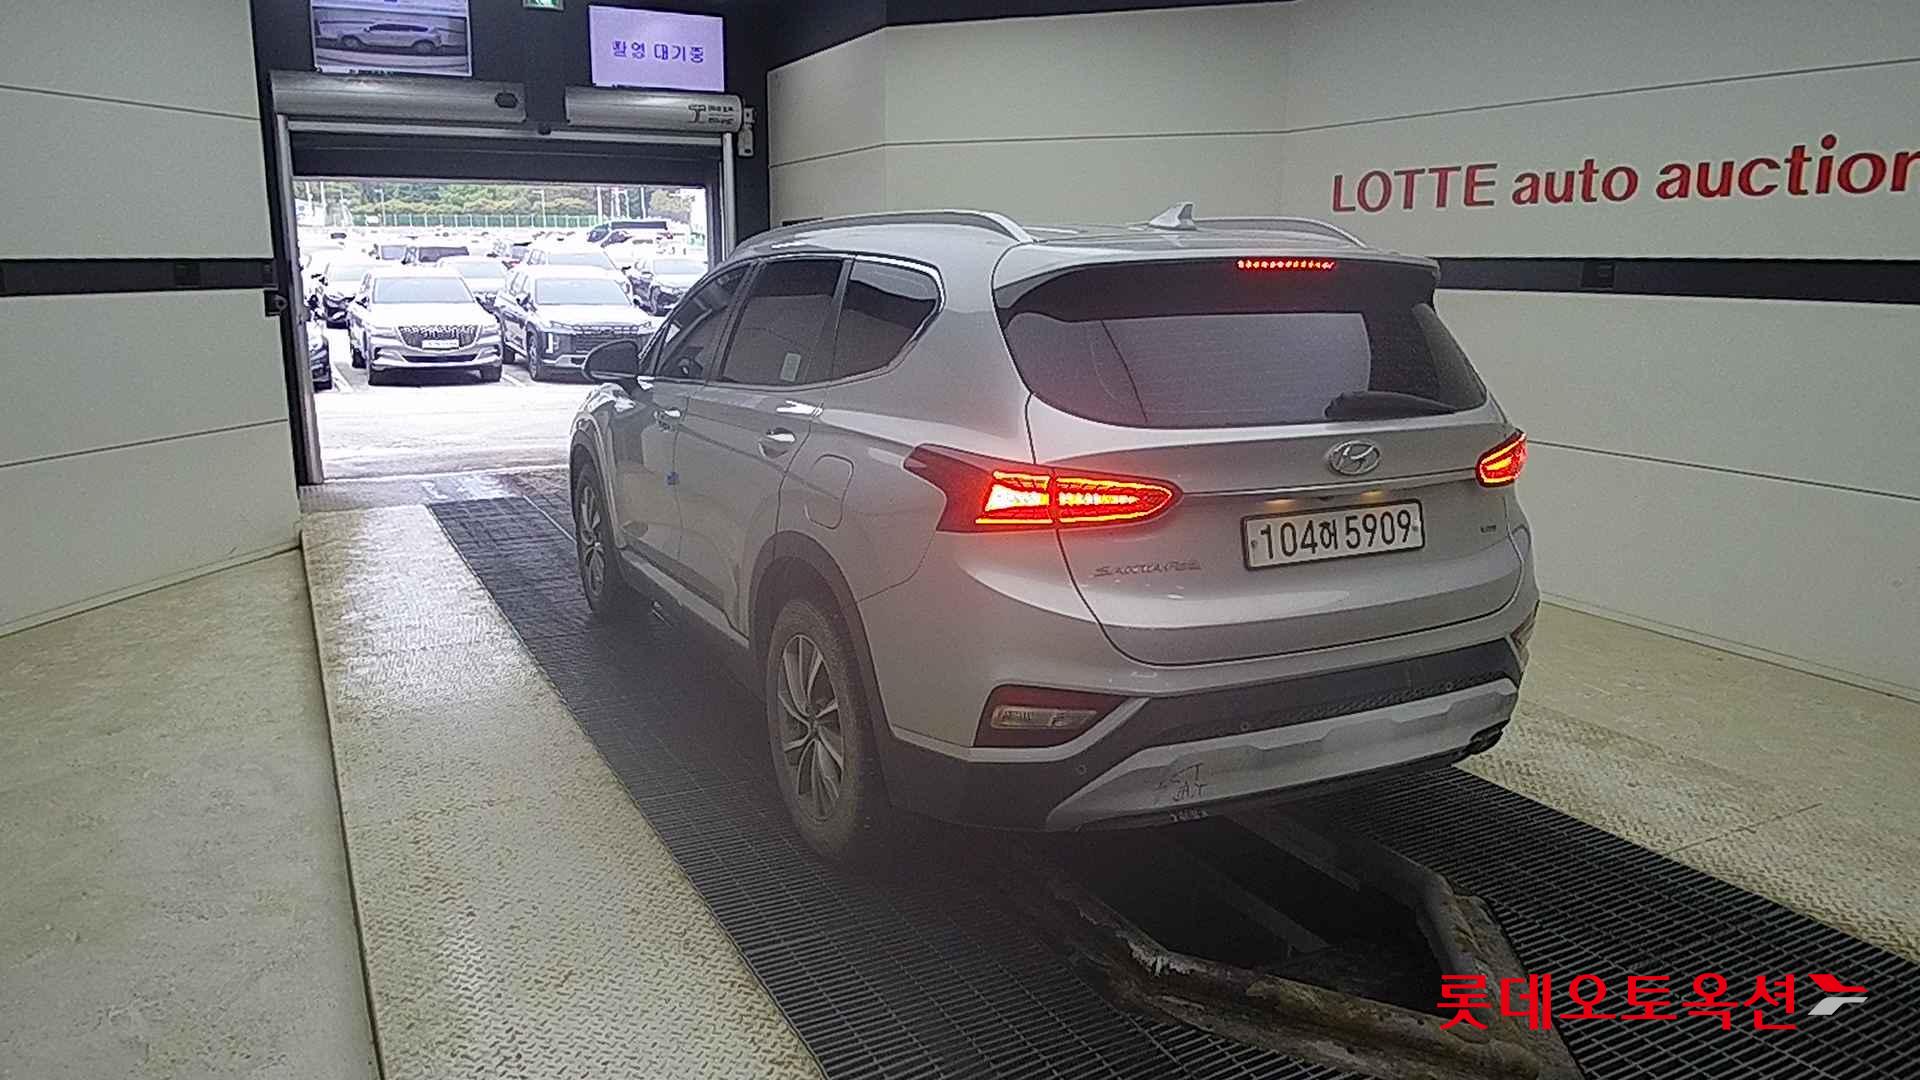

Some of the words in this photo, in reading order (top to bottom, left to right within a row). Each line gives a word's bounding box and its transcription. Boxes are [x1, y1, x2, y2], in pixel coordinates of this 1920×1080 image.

[653, 43, 705, 64] 대기중
[1331, 163, 1498, 212] LOTTE
[1512, 158, 1638, 205] auto
